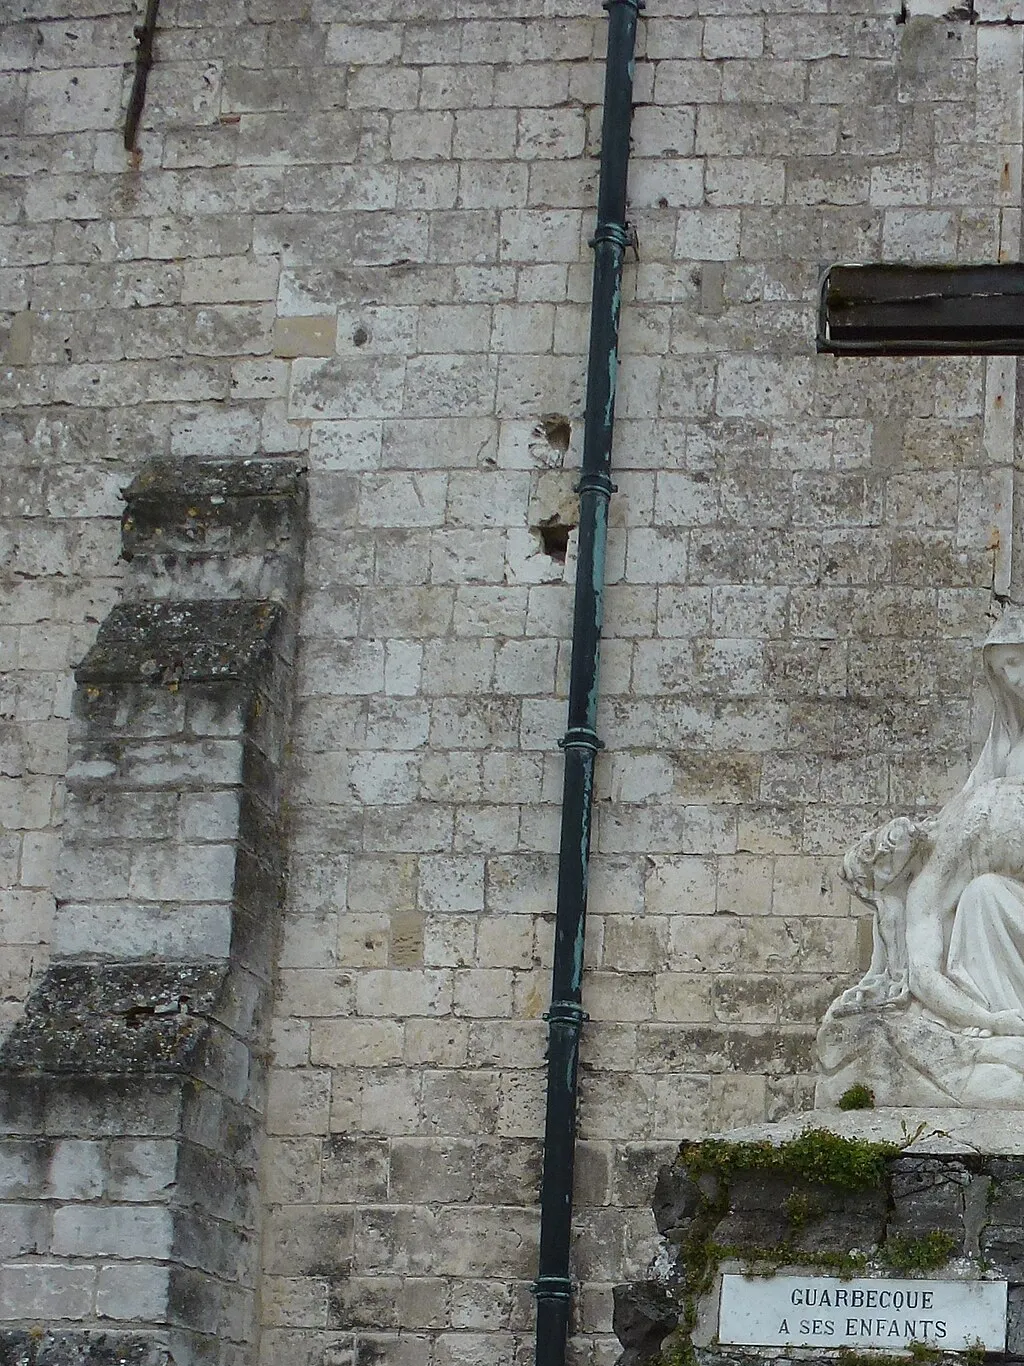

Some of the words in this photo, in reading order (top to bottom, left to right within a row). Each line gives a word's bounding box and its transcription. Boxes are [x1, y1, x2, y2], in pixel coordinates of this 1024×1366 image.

[791, 1288, 934, 1311] GUARBECQUE
[778, 1320, 791, 1335] A
[799, 1320, 835, 1336] SES
[845, 1318, 948, 1338] ENFANTS
